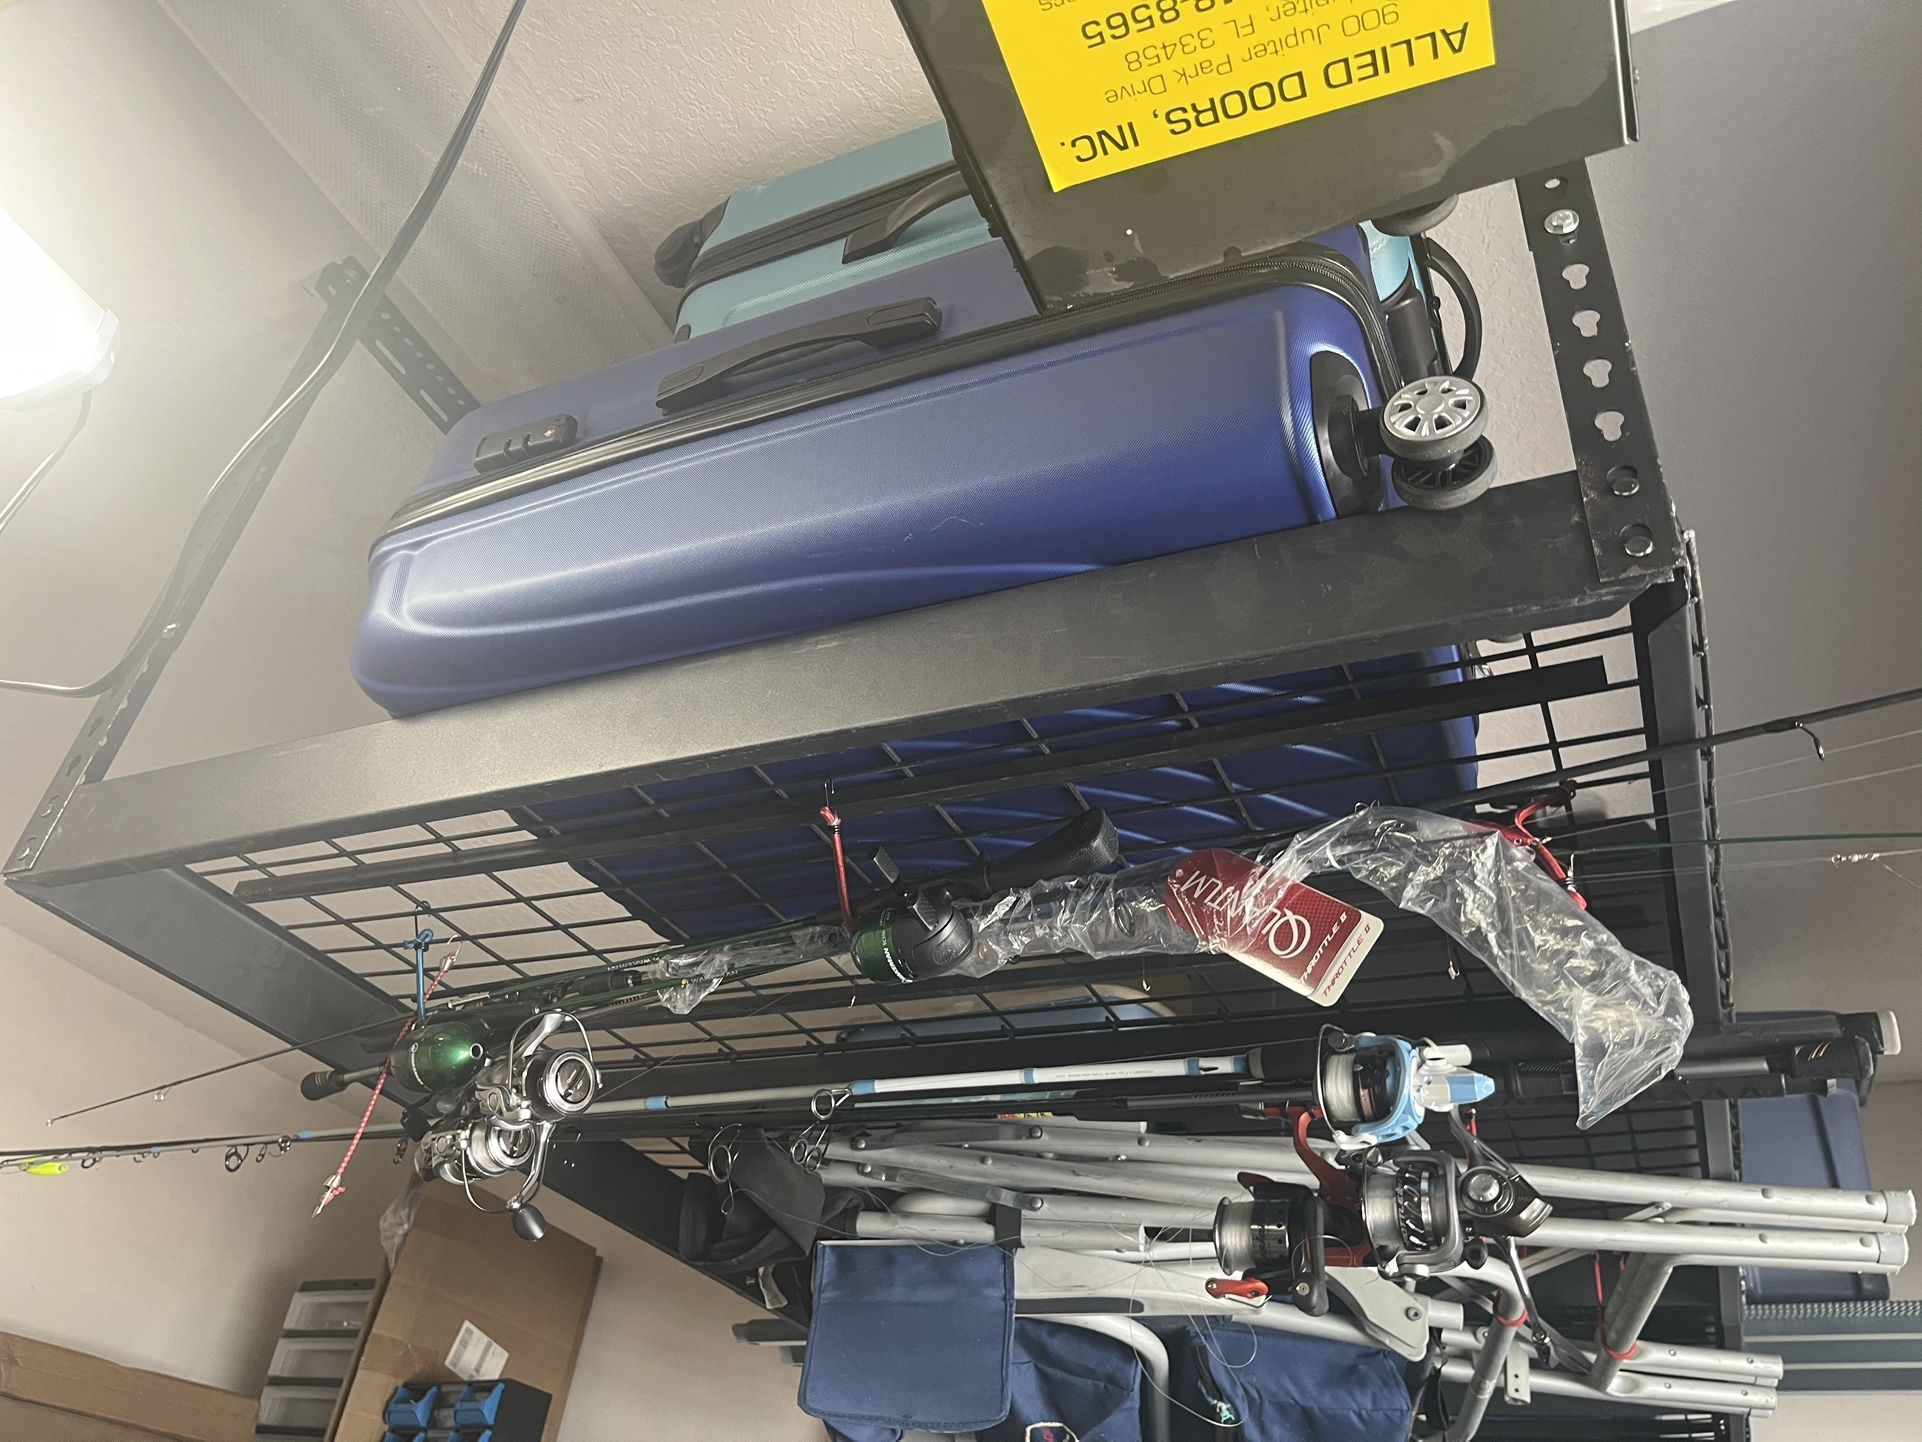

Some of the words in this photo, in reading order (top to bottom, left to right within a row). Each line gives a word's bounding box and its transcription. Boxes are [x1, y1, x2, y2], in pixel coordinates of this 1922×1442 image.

[1224, 15, 1256, 40] FL
[1342, 2, 1400, 37] 900
[1124, 26, 1215, 73] 33458
[1242, 24, 1331, 64] Jupiter
[1322, 21, 1469, 91] ALLIED
[1105, 74, 1167, 104] Drive
[1177, 51, 1233, 86] Park
[1152, 71, 1307, 137] DOORS,
[1059, 121, 1139, 163] INC.
[1300, 922, 1340, 984] THROTTLE
[1322, 936, 1364, 998] THROTTLE
